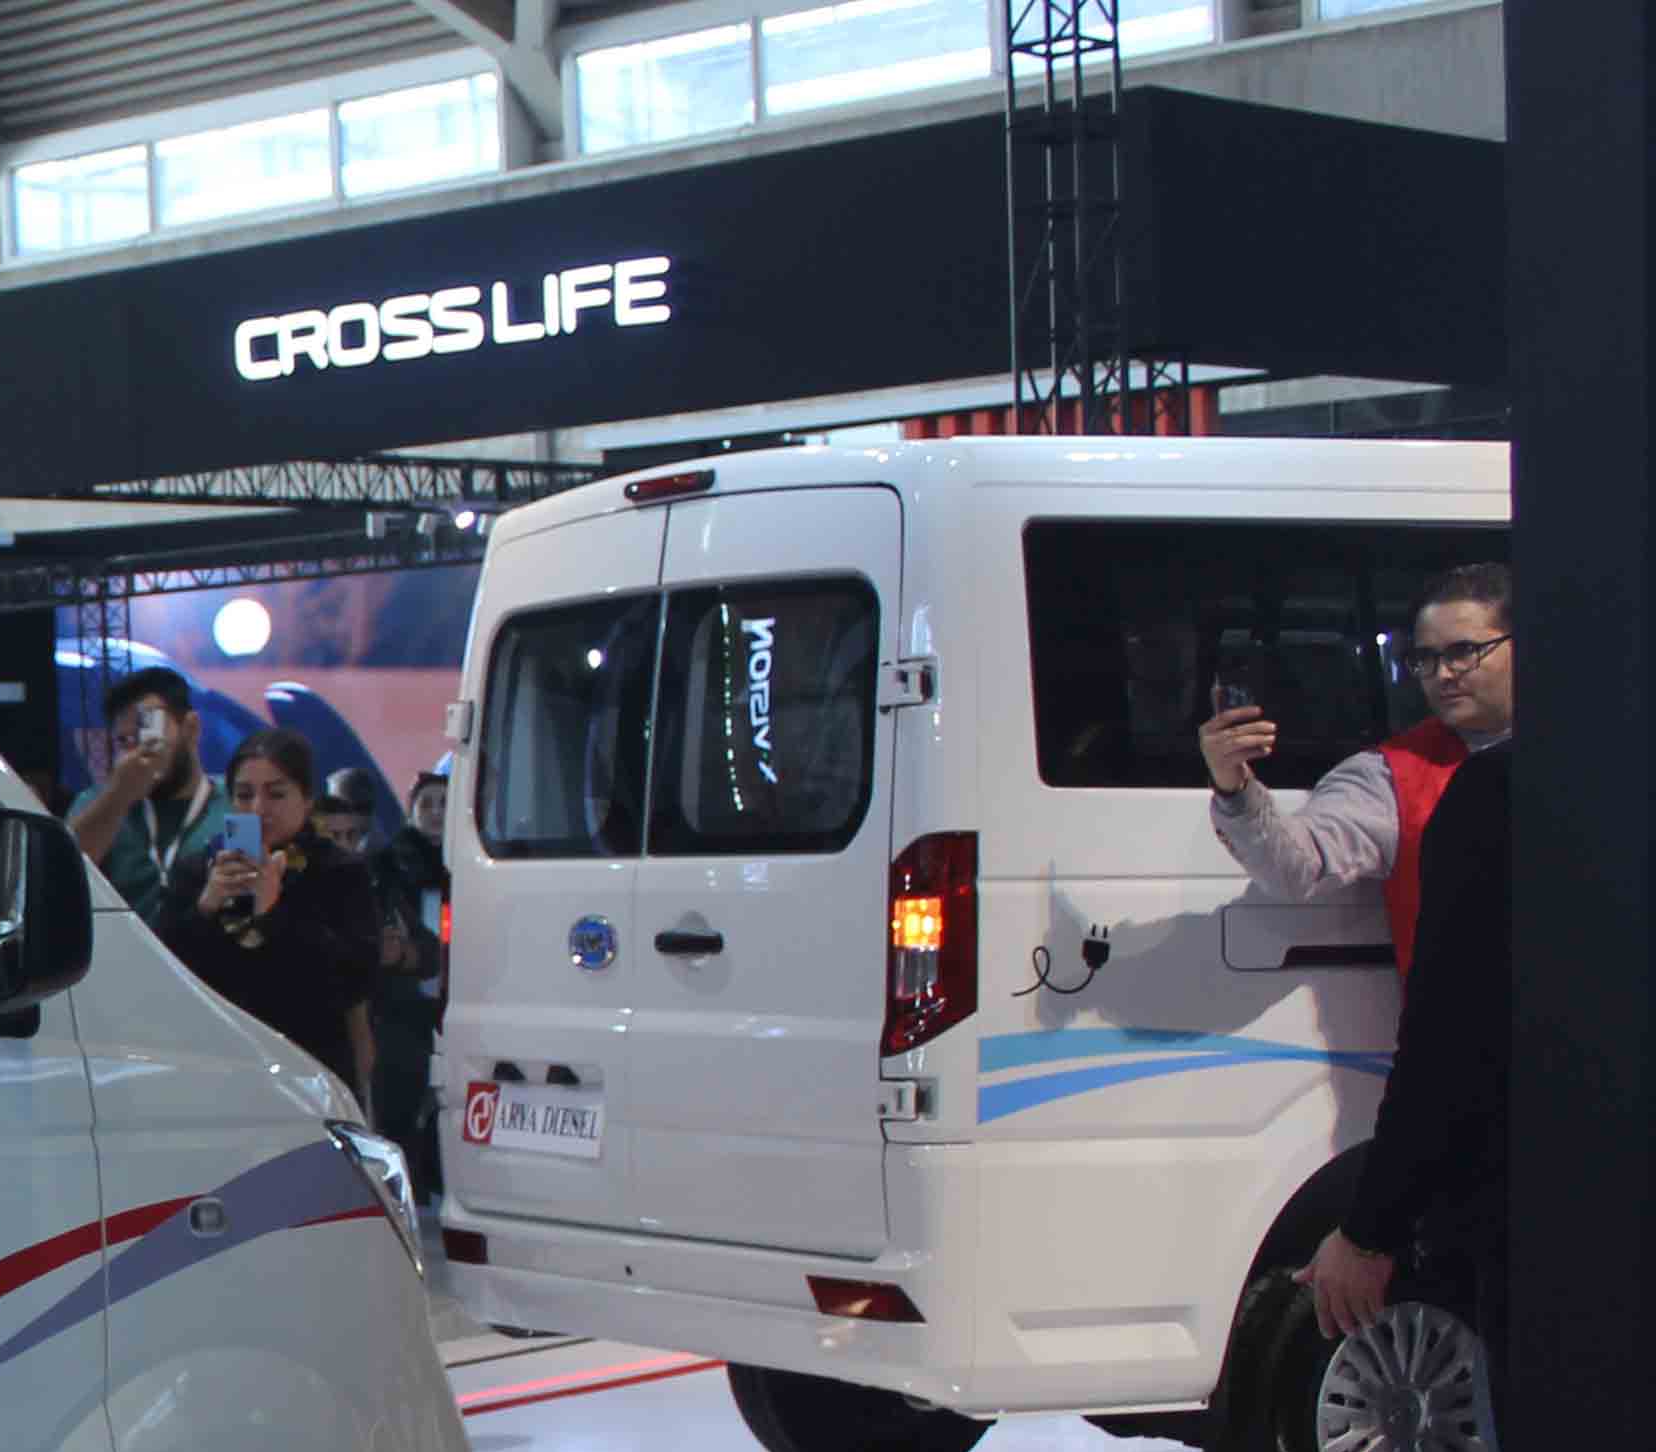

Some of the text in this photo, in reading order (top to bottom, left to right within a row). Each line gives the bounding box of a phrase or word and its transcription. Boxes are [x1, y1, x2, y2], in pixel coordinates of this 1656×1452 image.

[234, 256, 672, 381] CROSS LIFE
[541, 1105, 598, 1140] DIESEL
